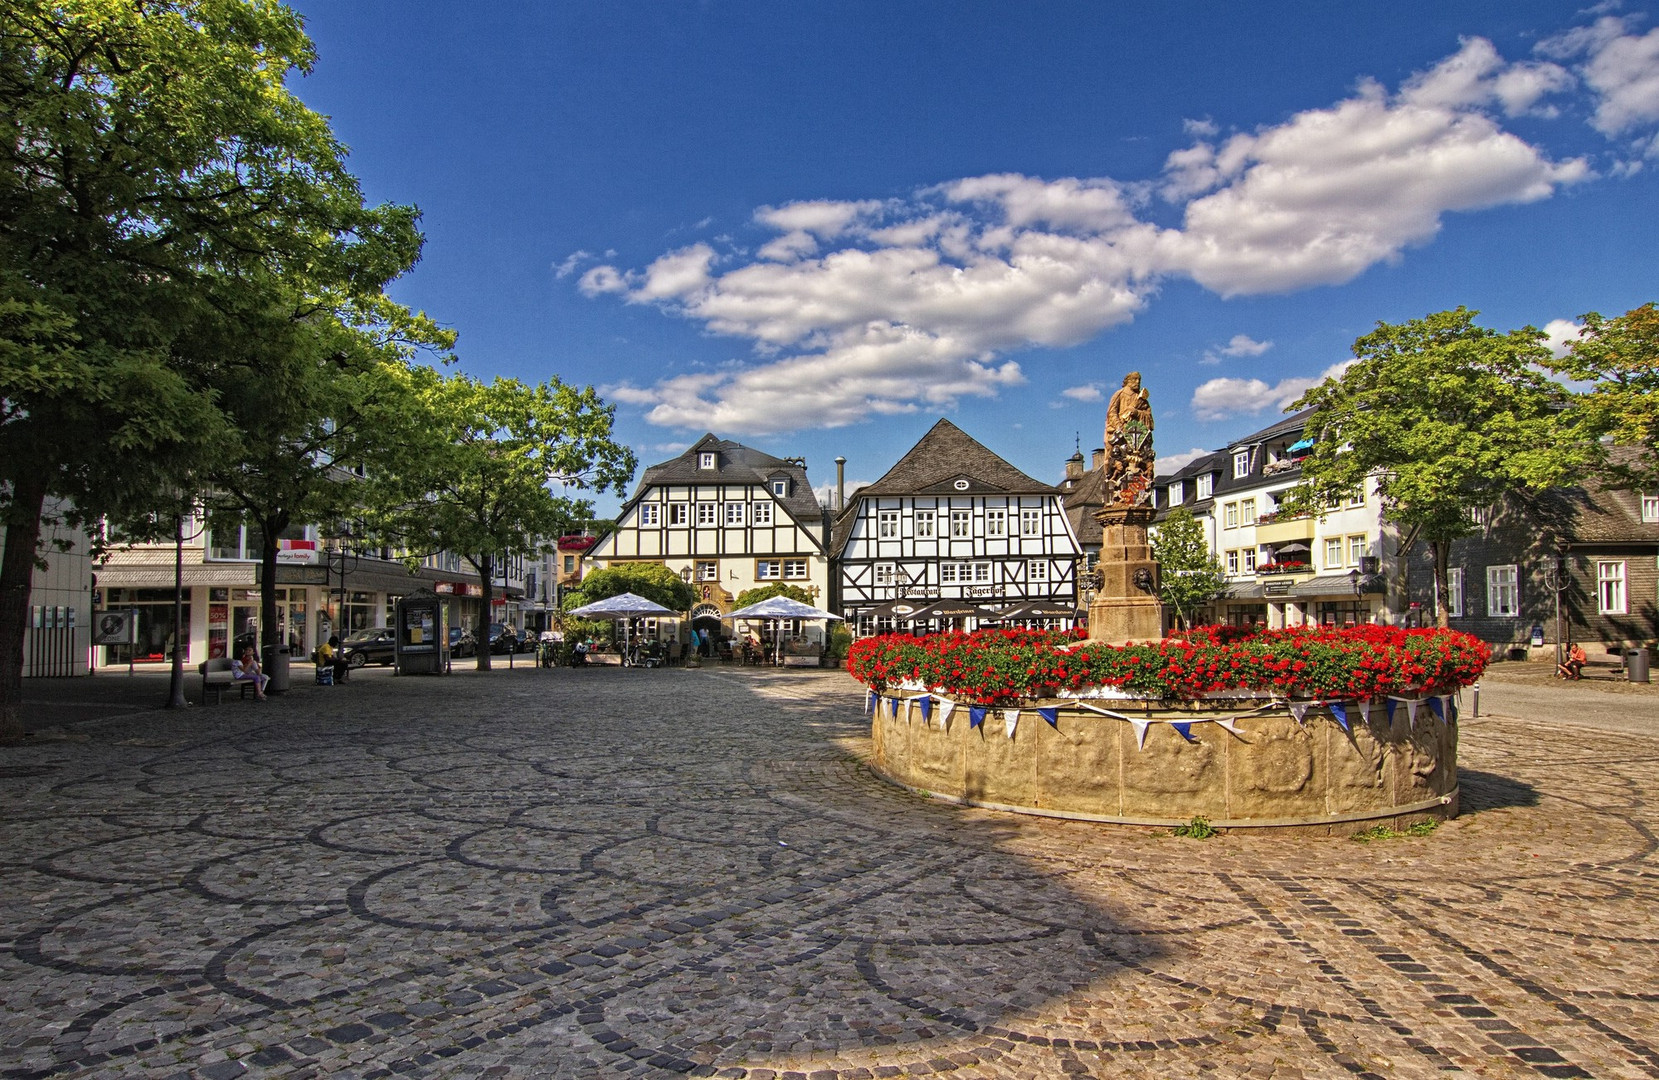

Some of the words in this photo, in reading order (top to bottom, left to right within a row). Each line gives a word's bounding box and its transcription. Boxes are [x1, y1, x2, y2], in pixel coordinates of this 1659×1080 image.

[294, 552, 310, 560] family
[899, 586, 941, 597] Restaurant
[965, 585, 1006, 598] Jägerhof
